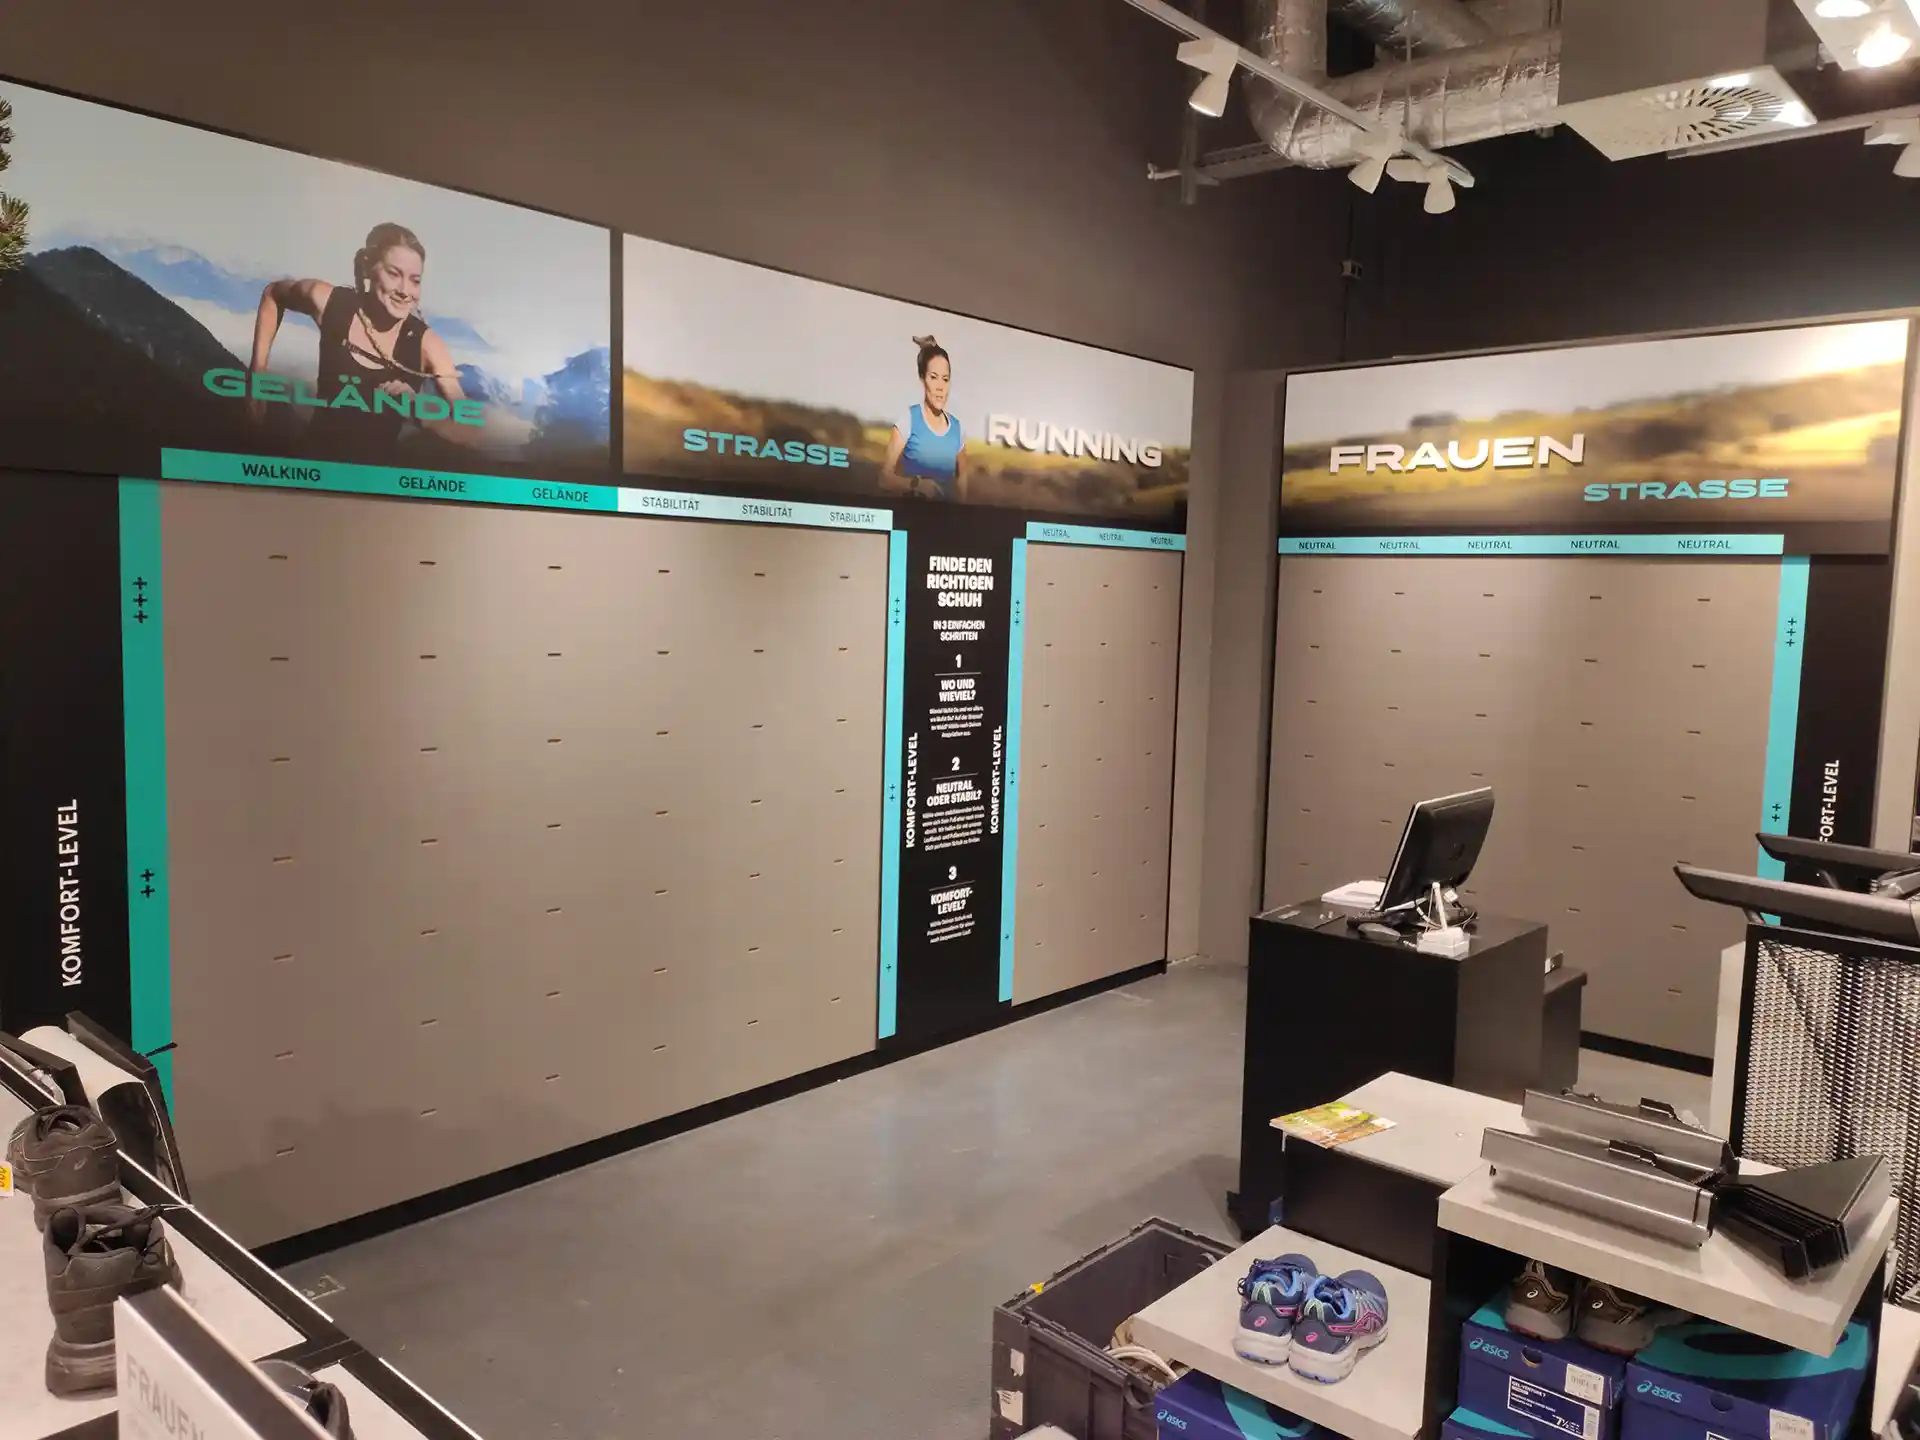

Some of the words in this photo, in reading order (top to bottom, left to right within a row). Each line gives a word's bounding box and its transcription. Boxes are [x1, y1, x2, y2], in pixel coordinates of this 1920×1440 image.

[202, 366, 486, 428] GELÄNDE
[683, 427, 850, 469] STRASSE
[986, 412, 1163, 469] RUNNING
[1329, 433, 1585, 474] FRAUEN
[242, 462, 321, 482] WALKING
[399, 475, 467, 493] GELÄNDE
[1583, 478, 1790, 502] STRASSE
[532, 486, 589, 504] GELÄNDE
[642, 496, 699, 511] STABILITÄT
[742, 504, 793, 518] STABILITÄT
[830, 511, 876, 524] STABILITÄT
[1043, 528, 1070, 538] NEUTRAL
[1099, 532, 1124, 542] NEUTRAL
[1150, 536, 1174, 546] NEUTRAL
[1299, 541, 1336, 550] NEUTRAL
[1379, 541, 1420, 550] NEUTRAL
[1468, 540, 1512, 550] NEUTRAL
[1570, 540, 1620, 549] NEUTRAL
[1677, 540, 1731, 549] NEUTRAL
[929, 556, 966, 573] FINDE
[967, 557, 992, 574] DEN
[927, 573, 994, 591] RICHTIGEN
[938, 592, 982, 607] SCHUH
[933, 620, 942, 631] IN
[942, 620, 947, 631] 3
[948, 620, 985, 631] EINFACHEN
[940, 631, 978, 641] SCHRITTEN
[955, 653, 962, 669] 1
[941, 679, 956, 691] WO
[957, 678, 975, 690] UND
[939, 689, 976, 702] WIEVIEL?
[951, 756, 960, 772] 2
[936, 780, 974, 795] NEUTRAL
[990, 725, 1002, 835] KOMFORT-LEVEL
[905, 731, 919, 849] KOMFORT-LEVEL
[926, 794, 950, 807] ODER
[951, 789, 982, 804] STABIL?
[948, 865, 957, 881] 3
[57, 798, 83, 987] KOMFORT-LEVEL
[930, 887, 974, 905] KOMFORT-
[937, 899, 967, 915] LEVEL?
[1482, 1343, 1510, 1361] asics
[1651, 1385, 1683, 1403] asics
[1166, 1414, 1188, 1430] asics
